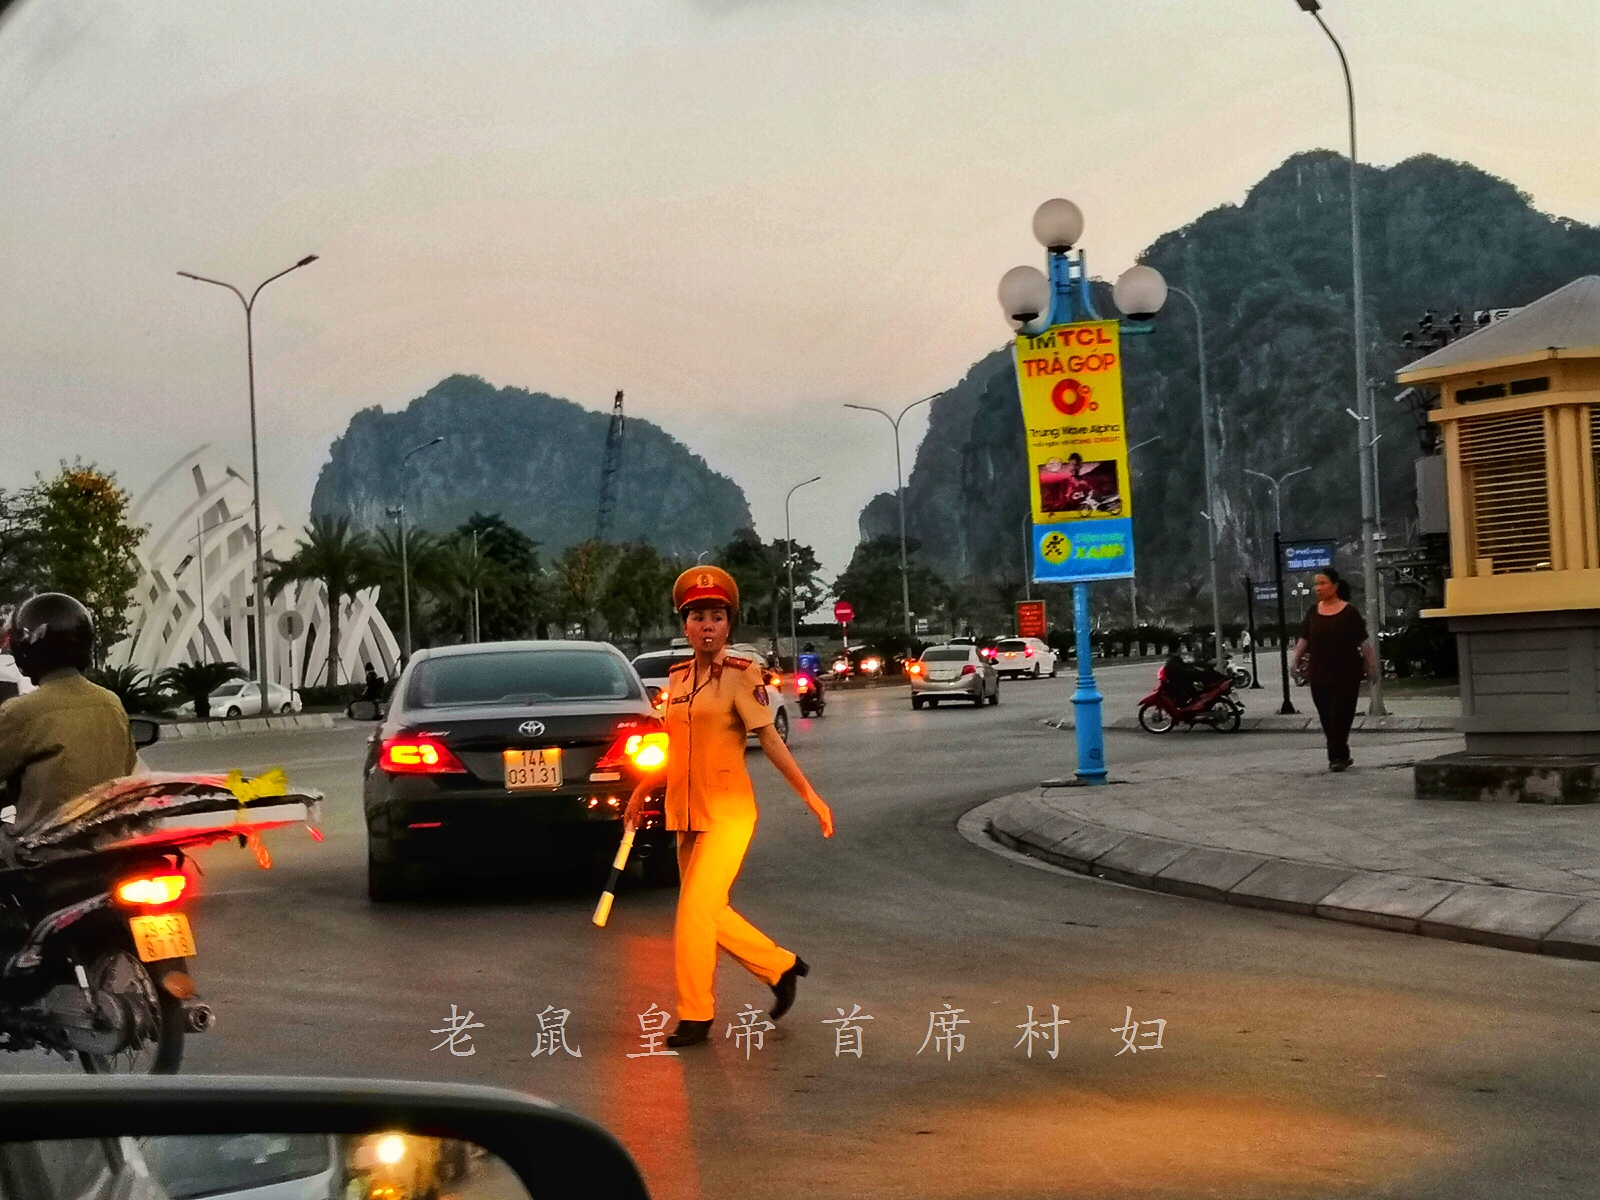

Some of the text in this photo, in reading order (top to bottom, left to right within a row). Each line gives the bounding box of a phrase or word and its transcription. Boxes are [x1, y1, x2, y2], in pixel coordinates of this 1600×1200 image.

[1057, 328, 1112, 347] TCL
[1022, 348, 1116, 377] TRẢ GÓP
[521, 751, 546, 767] 14A
